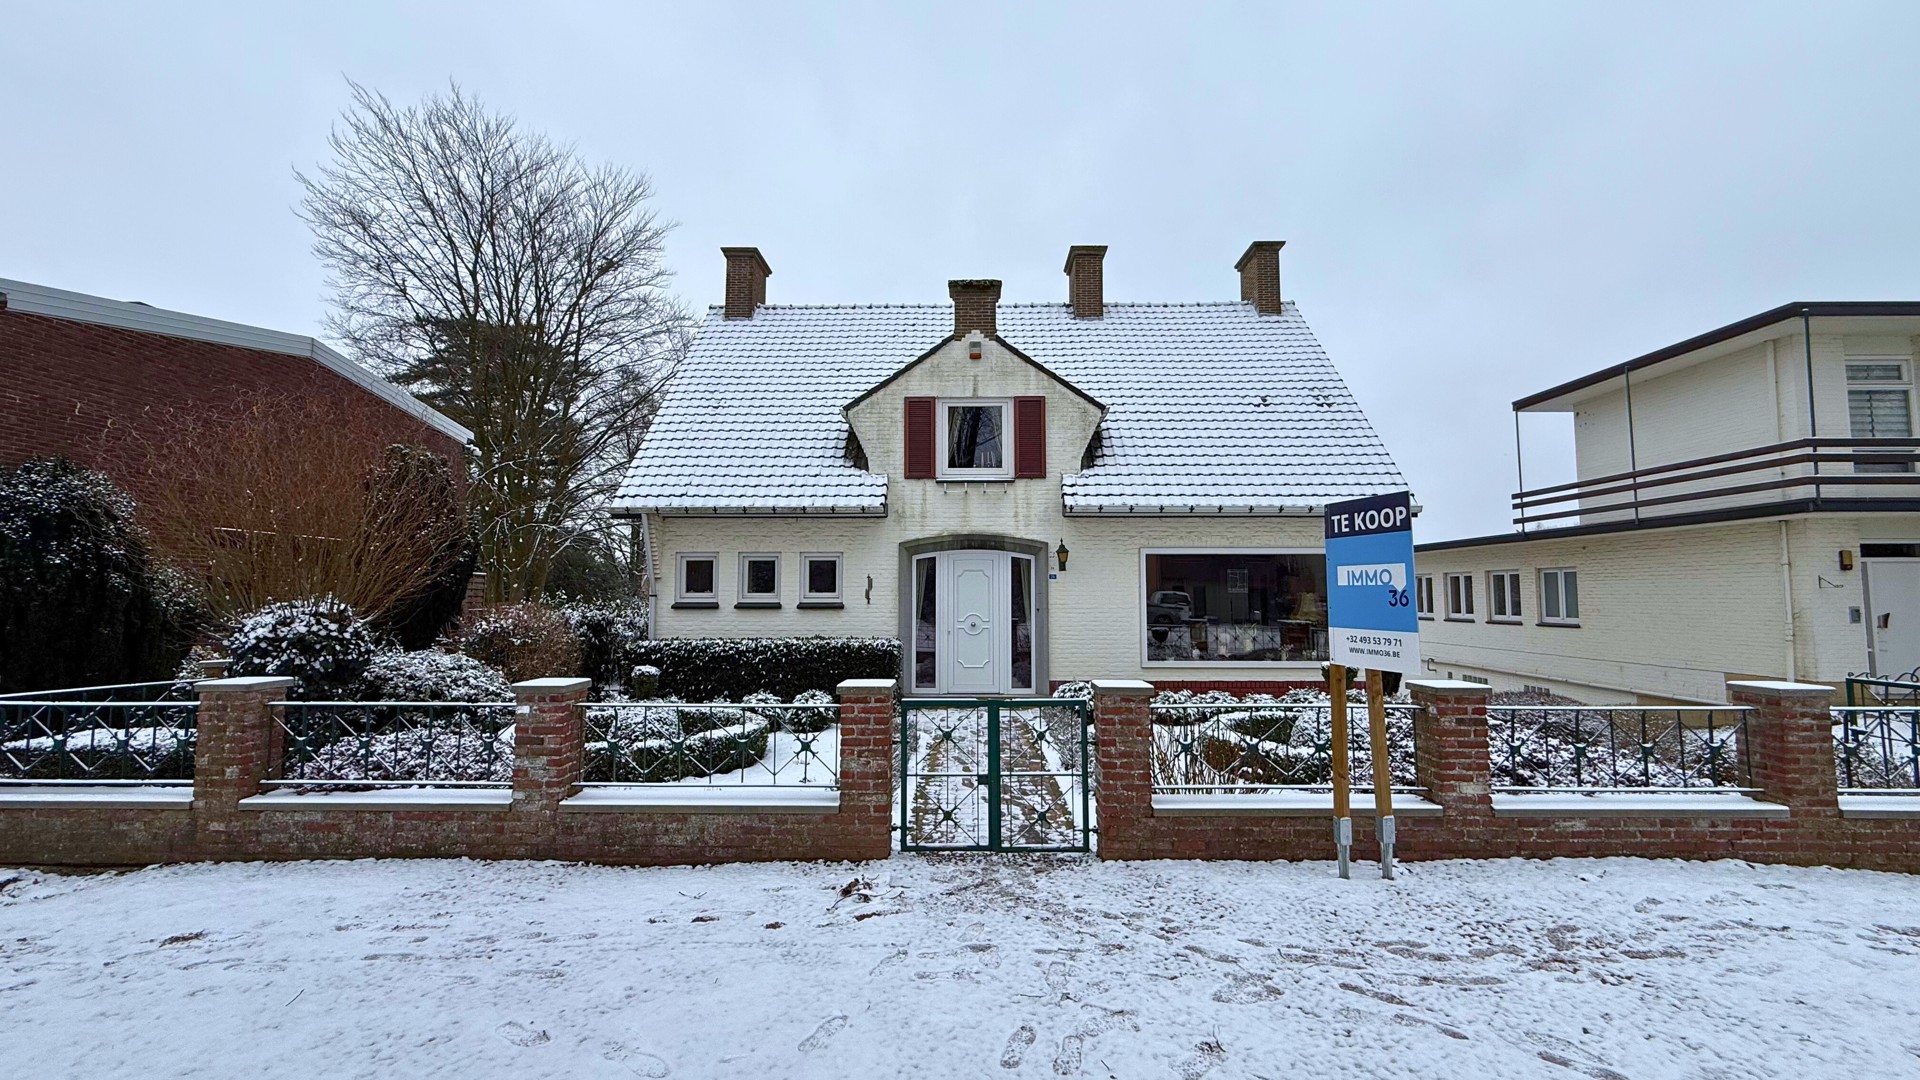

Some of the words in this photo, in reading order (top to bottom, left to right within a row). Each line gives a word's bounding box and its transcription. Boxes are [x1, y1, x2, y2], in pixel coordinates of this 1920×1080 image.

[1331, 514, 1350, 533] TE
[1354, 506, 1407, 531] KOOP
[1347, 569, 1392, 586] IMMO
[1388, 590, 1409, 607] 36
[1346, 635, 1358, 643] +32
[1359, 636, 1371, 645] 493
[1372, 637, 1381, 646] 53
[1382, 637, 1392, 646] 79
[1393, 638, 1402, 647] 71
[1349, 647, 1401, 658] WWW.IMMO36.BE
